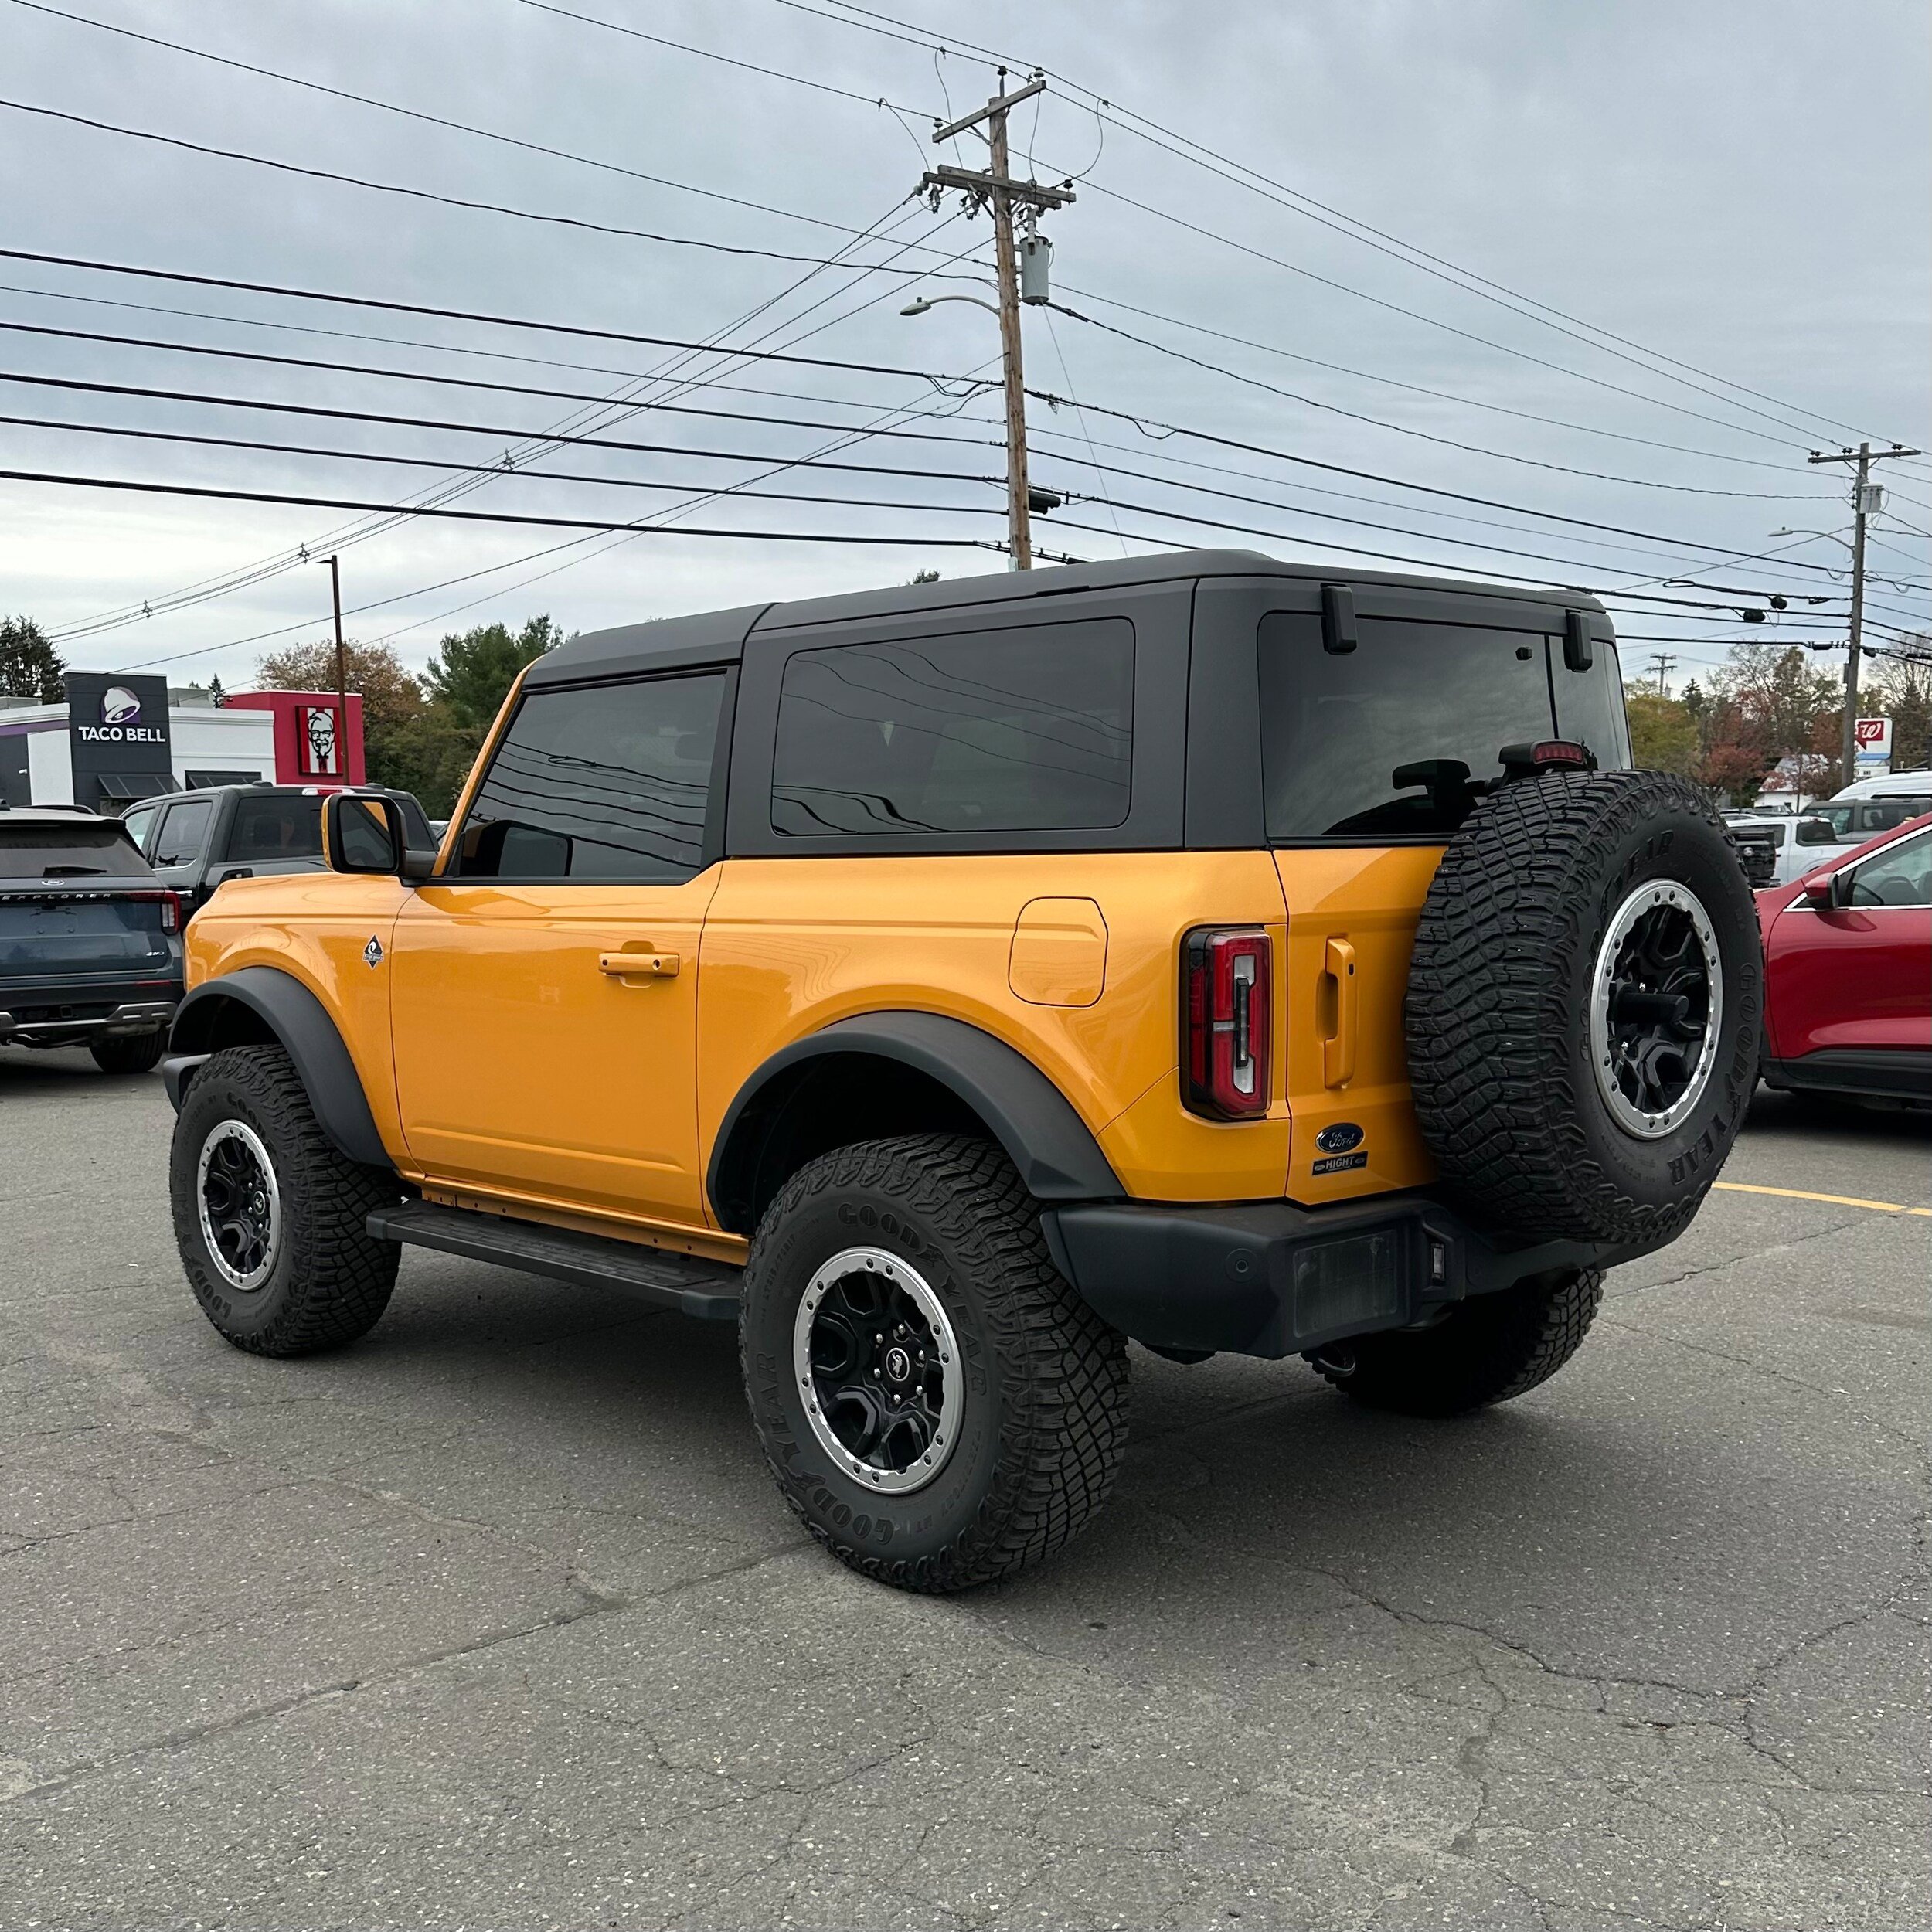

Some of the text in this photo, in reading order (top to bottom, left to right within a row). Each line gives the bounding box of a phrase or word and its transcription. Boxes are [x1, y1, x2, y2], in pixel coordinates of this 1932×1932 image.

[78, 726, 165, 742] TACO BELL
[1325, 1156, 1355, 1170] HIGHT
